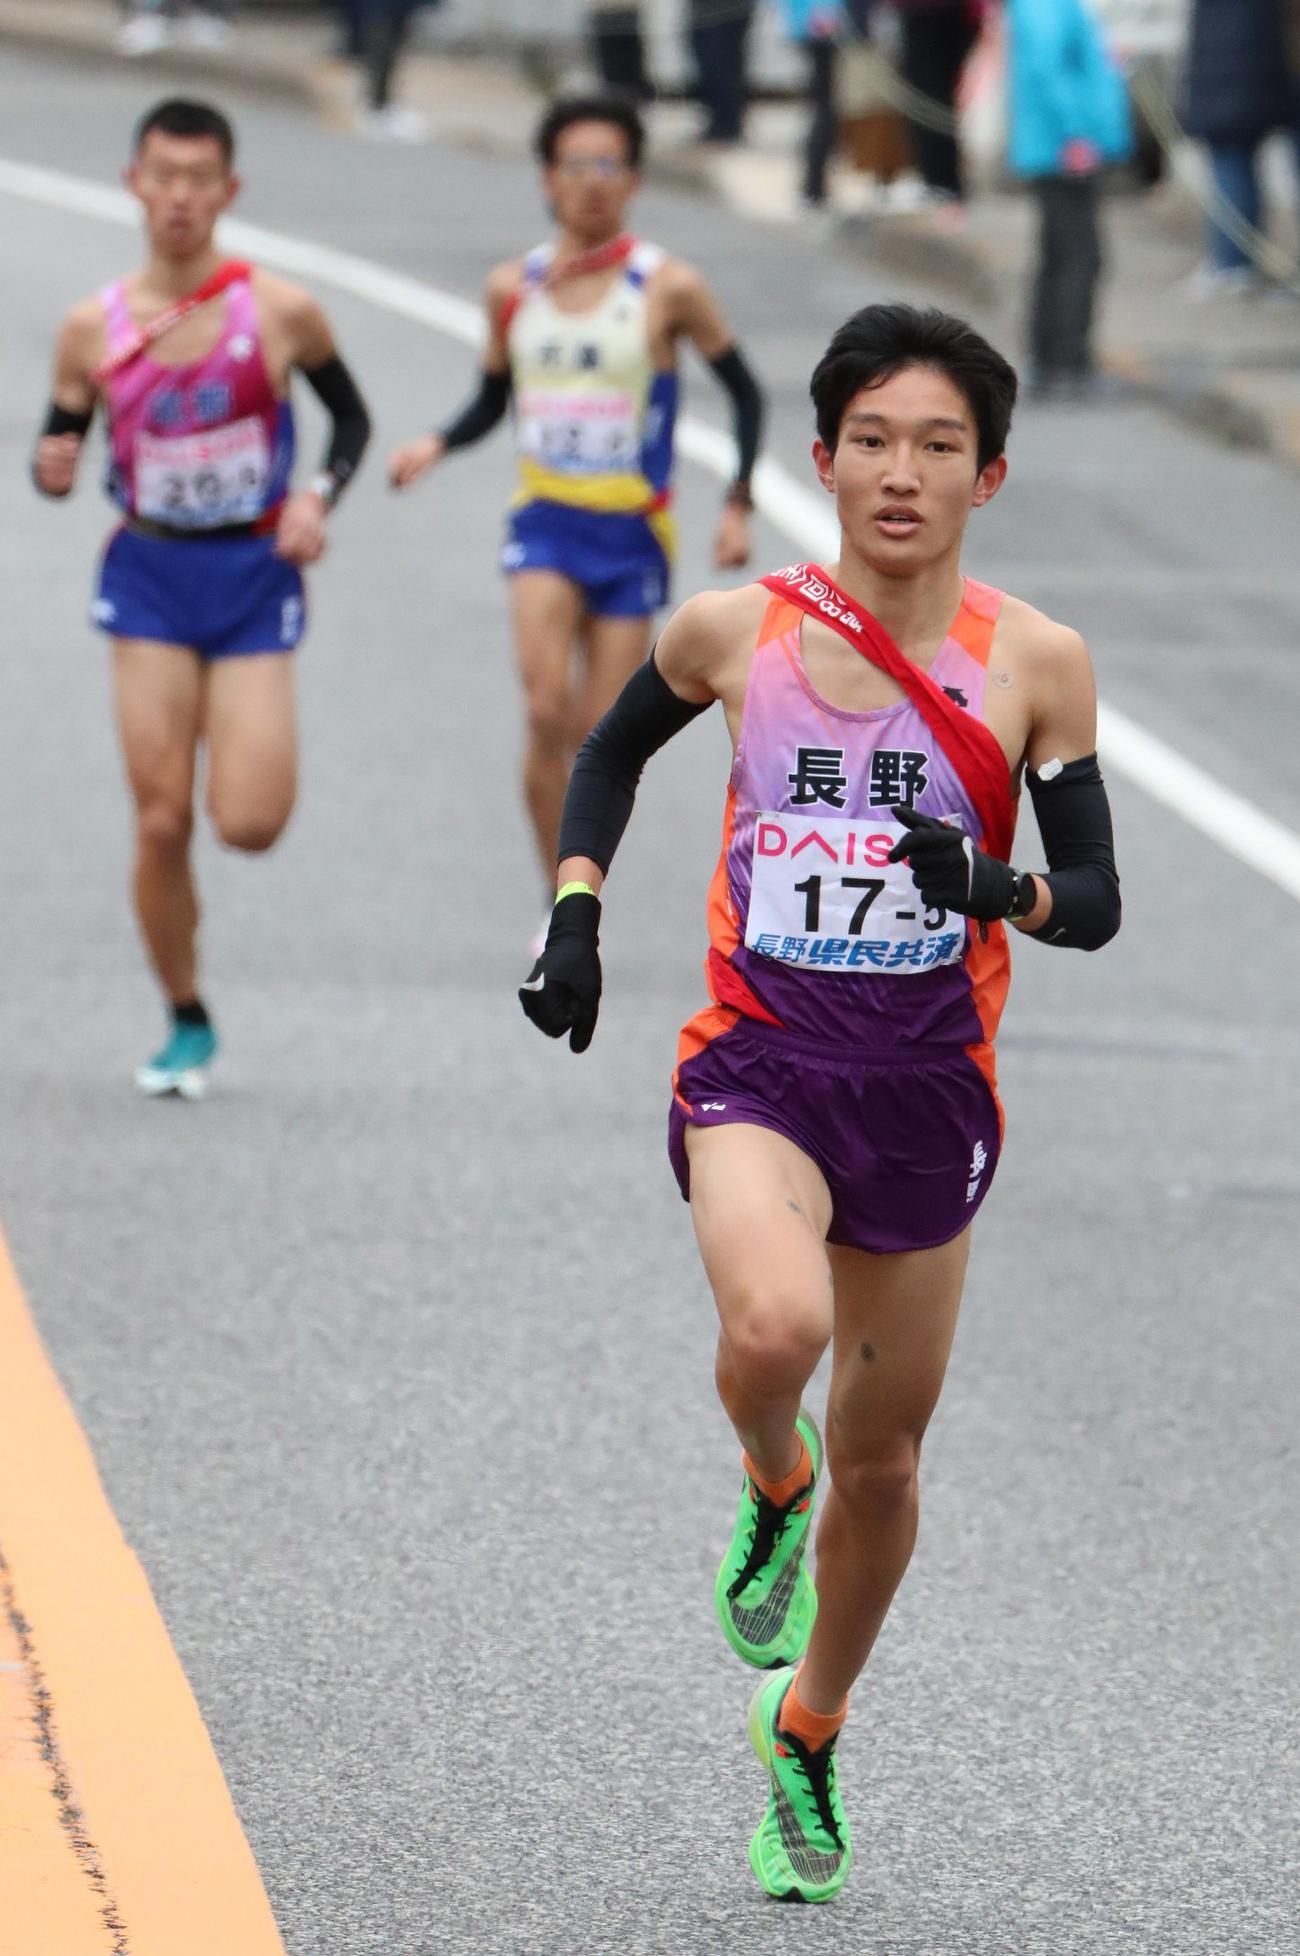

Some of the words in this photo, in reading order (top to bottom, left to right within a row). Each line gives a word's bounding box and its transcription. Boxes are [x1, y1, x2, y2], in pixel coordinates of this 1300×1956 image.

[788, 745, 929, 810] 長野
[757, 822, 913, 868] DAIS
[752, 932, 961, 969] 長野県民共済
